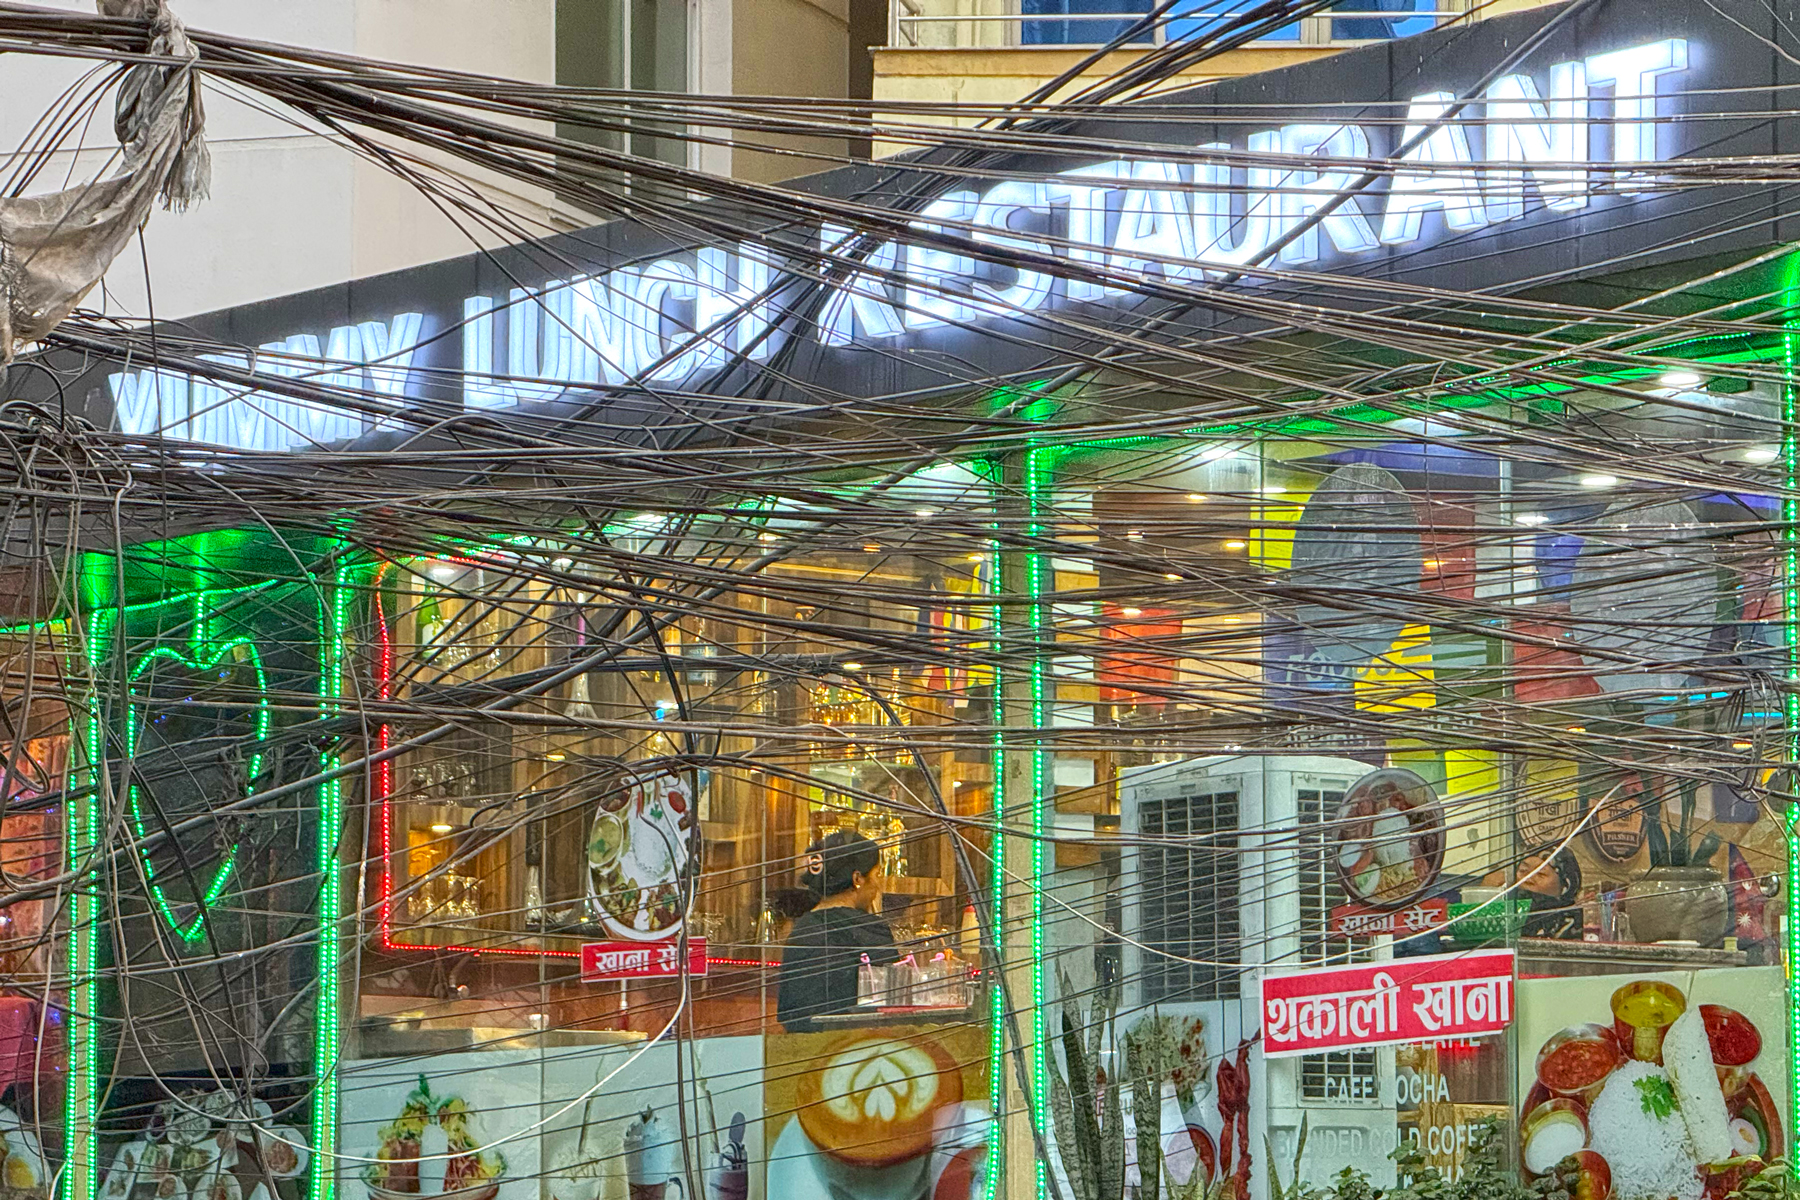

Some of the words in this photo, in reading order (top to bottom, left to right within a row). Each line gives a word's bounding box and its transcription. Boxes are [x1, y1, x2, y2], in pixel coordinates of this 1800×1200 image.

[464, 238, 771, 412] LUNCH
[818, 38, 1689, 348] RESTAURANT
[596, 949, 652, 975] खाना
[1267, 971, 1401, 1043] थकाली
[1412, 975, 1513, 1032] खाना
[1394, 1073, 1450, 1105] OCHA
